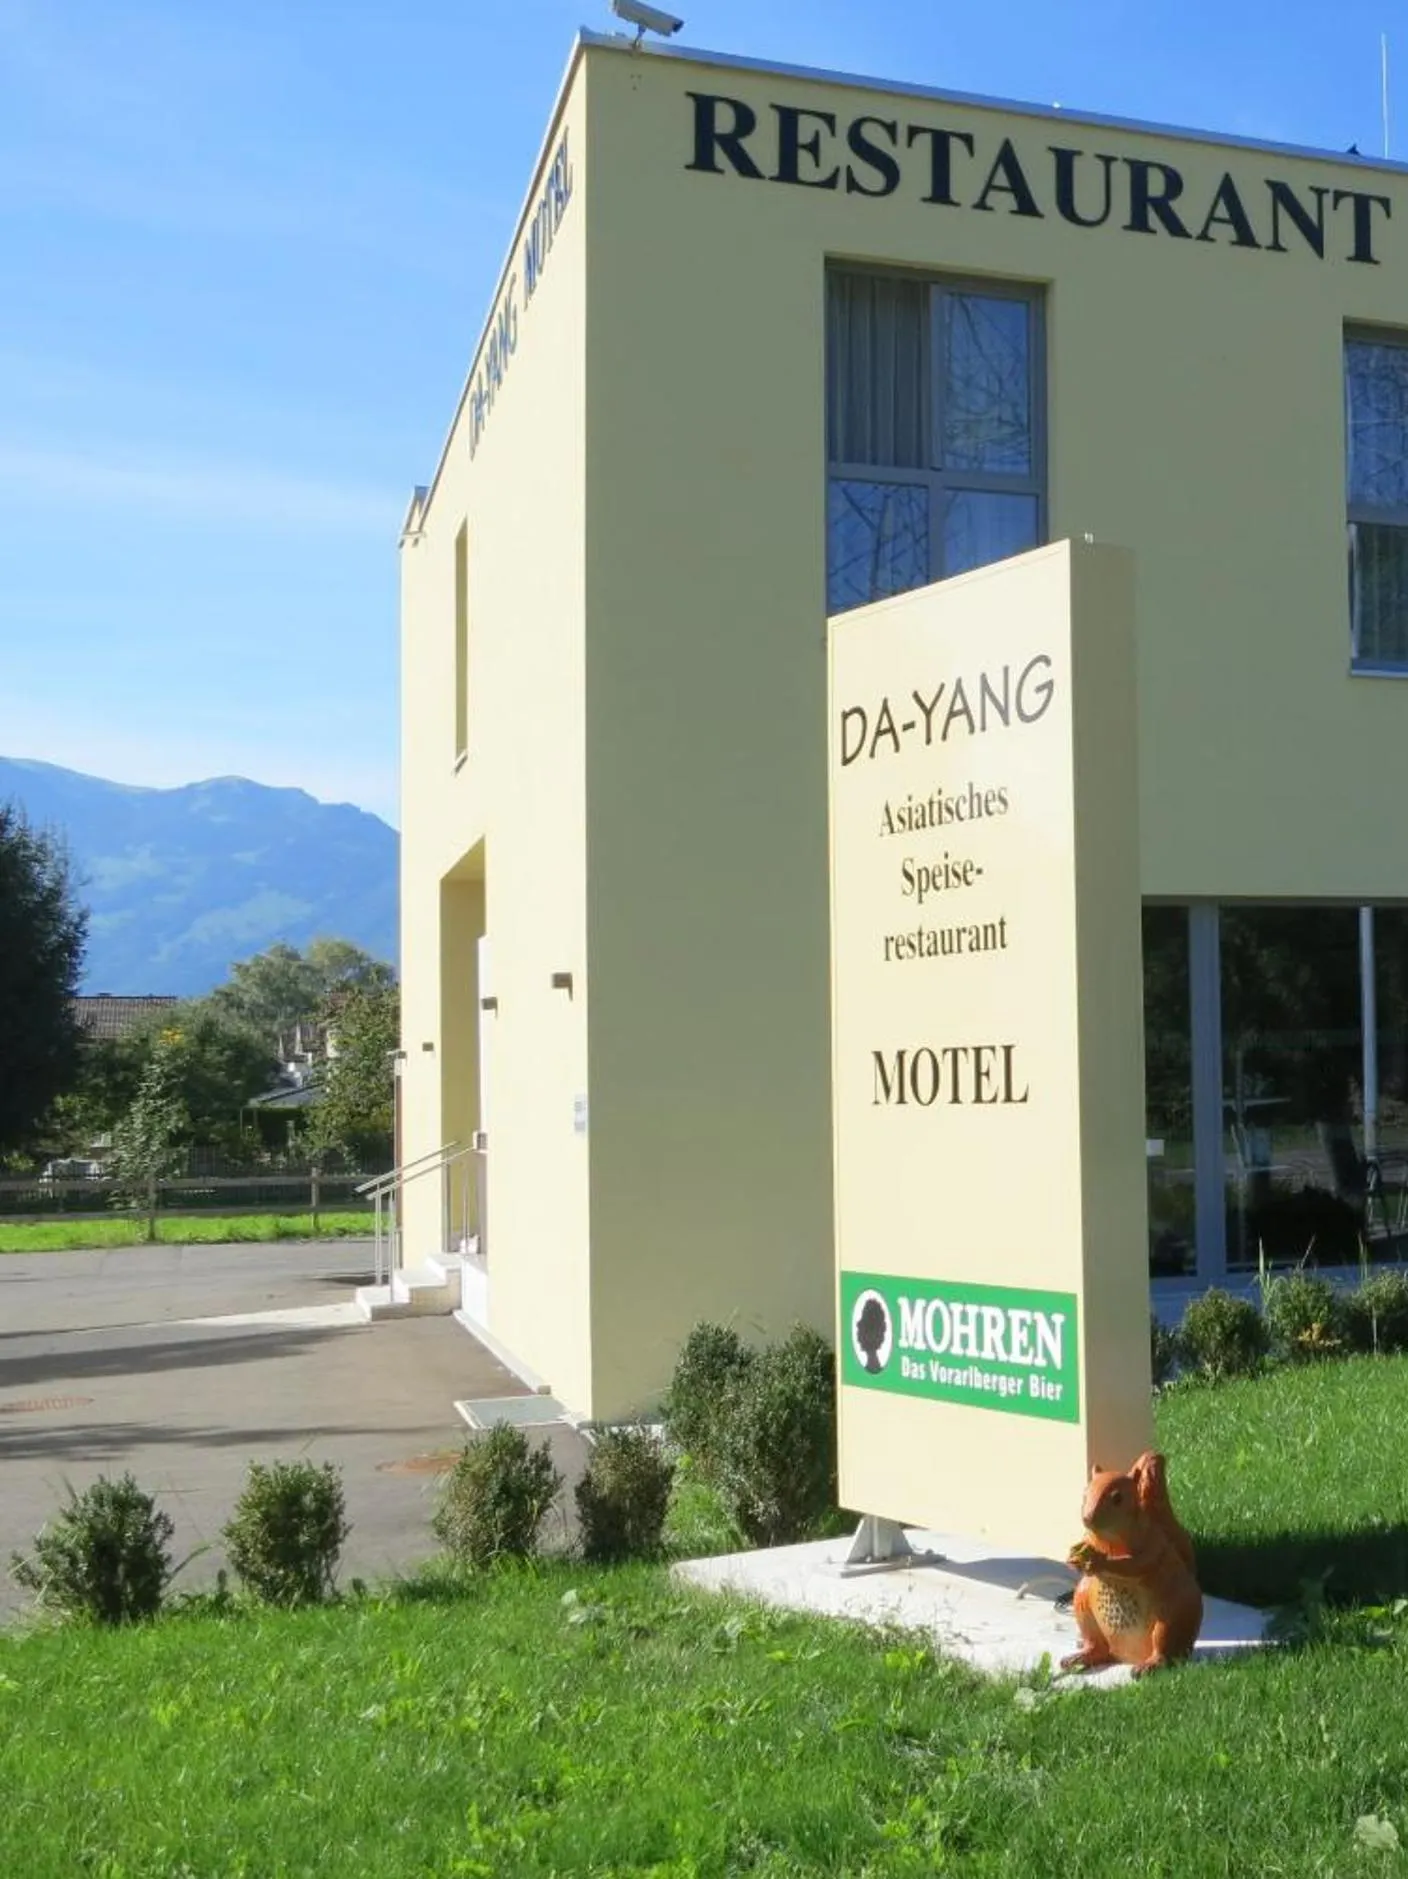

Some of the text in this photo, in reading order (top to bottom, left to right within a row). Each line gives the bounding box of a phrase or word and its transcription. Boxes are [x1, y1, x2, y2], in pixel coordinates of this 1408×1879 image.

[684, 91, 1392, 264] RESTAURANT
[840, 654, 1055, 766] DA-YANG
[878, 781, 1009, 837] Asiatisches
[900, 851, 984, 904] Speise-
[883, 915, 1008, 961] restaurant
[871, 1044, 1030, 1106] MOTEL
[897, 1297, 1064, 1369] MOHREN
[901, 1356, 1063, 1400] Das Vorarlberger Bier
